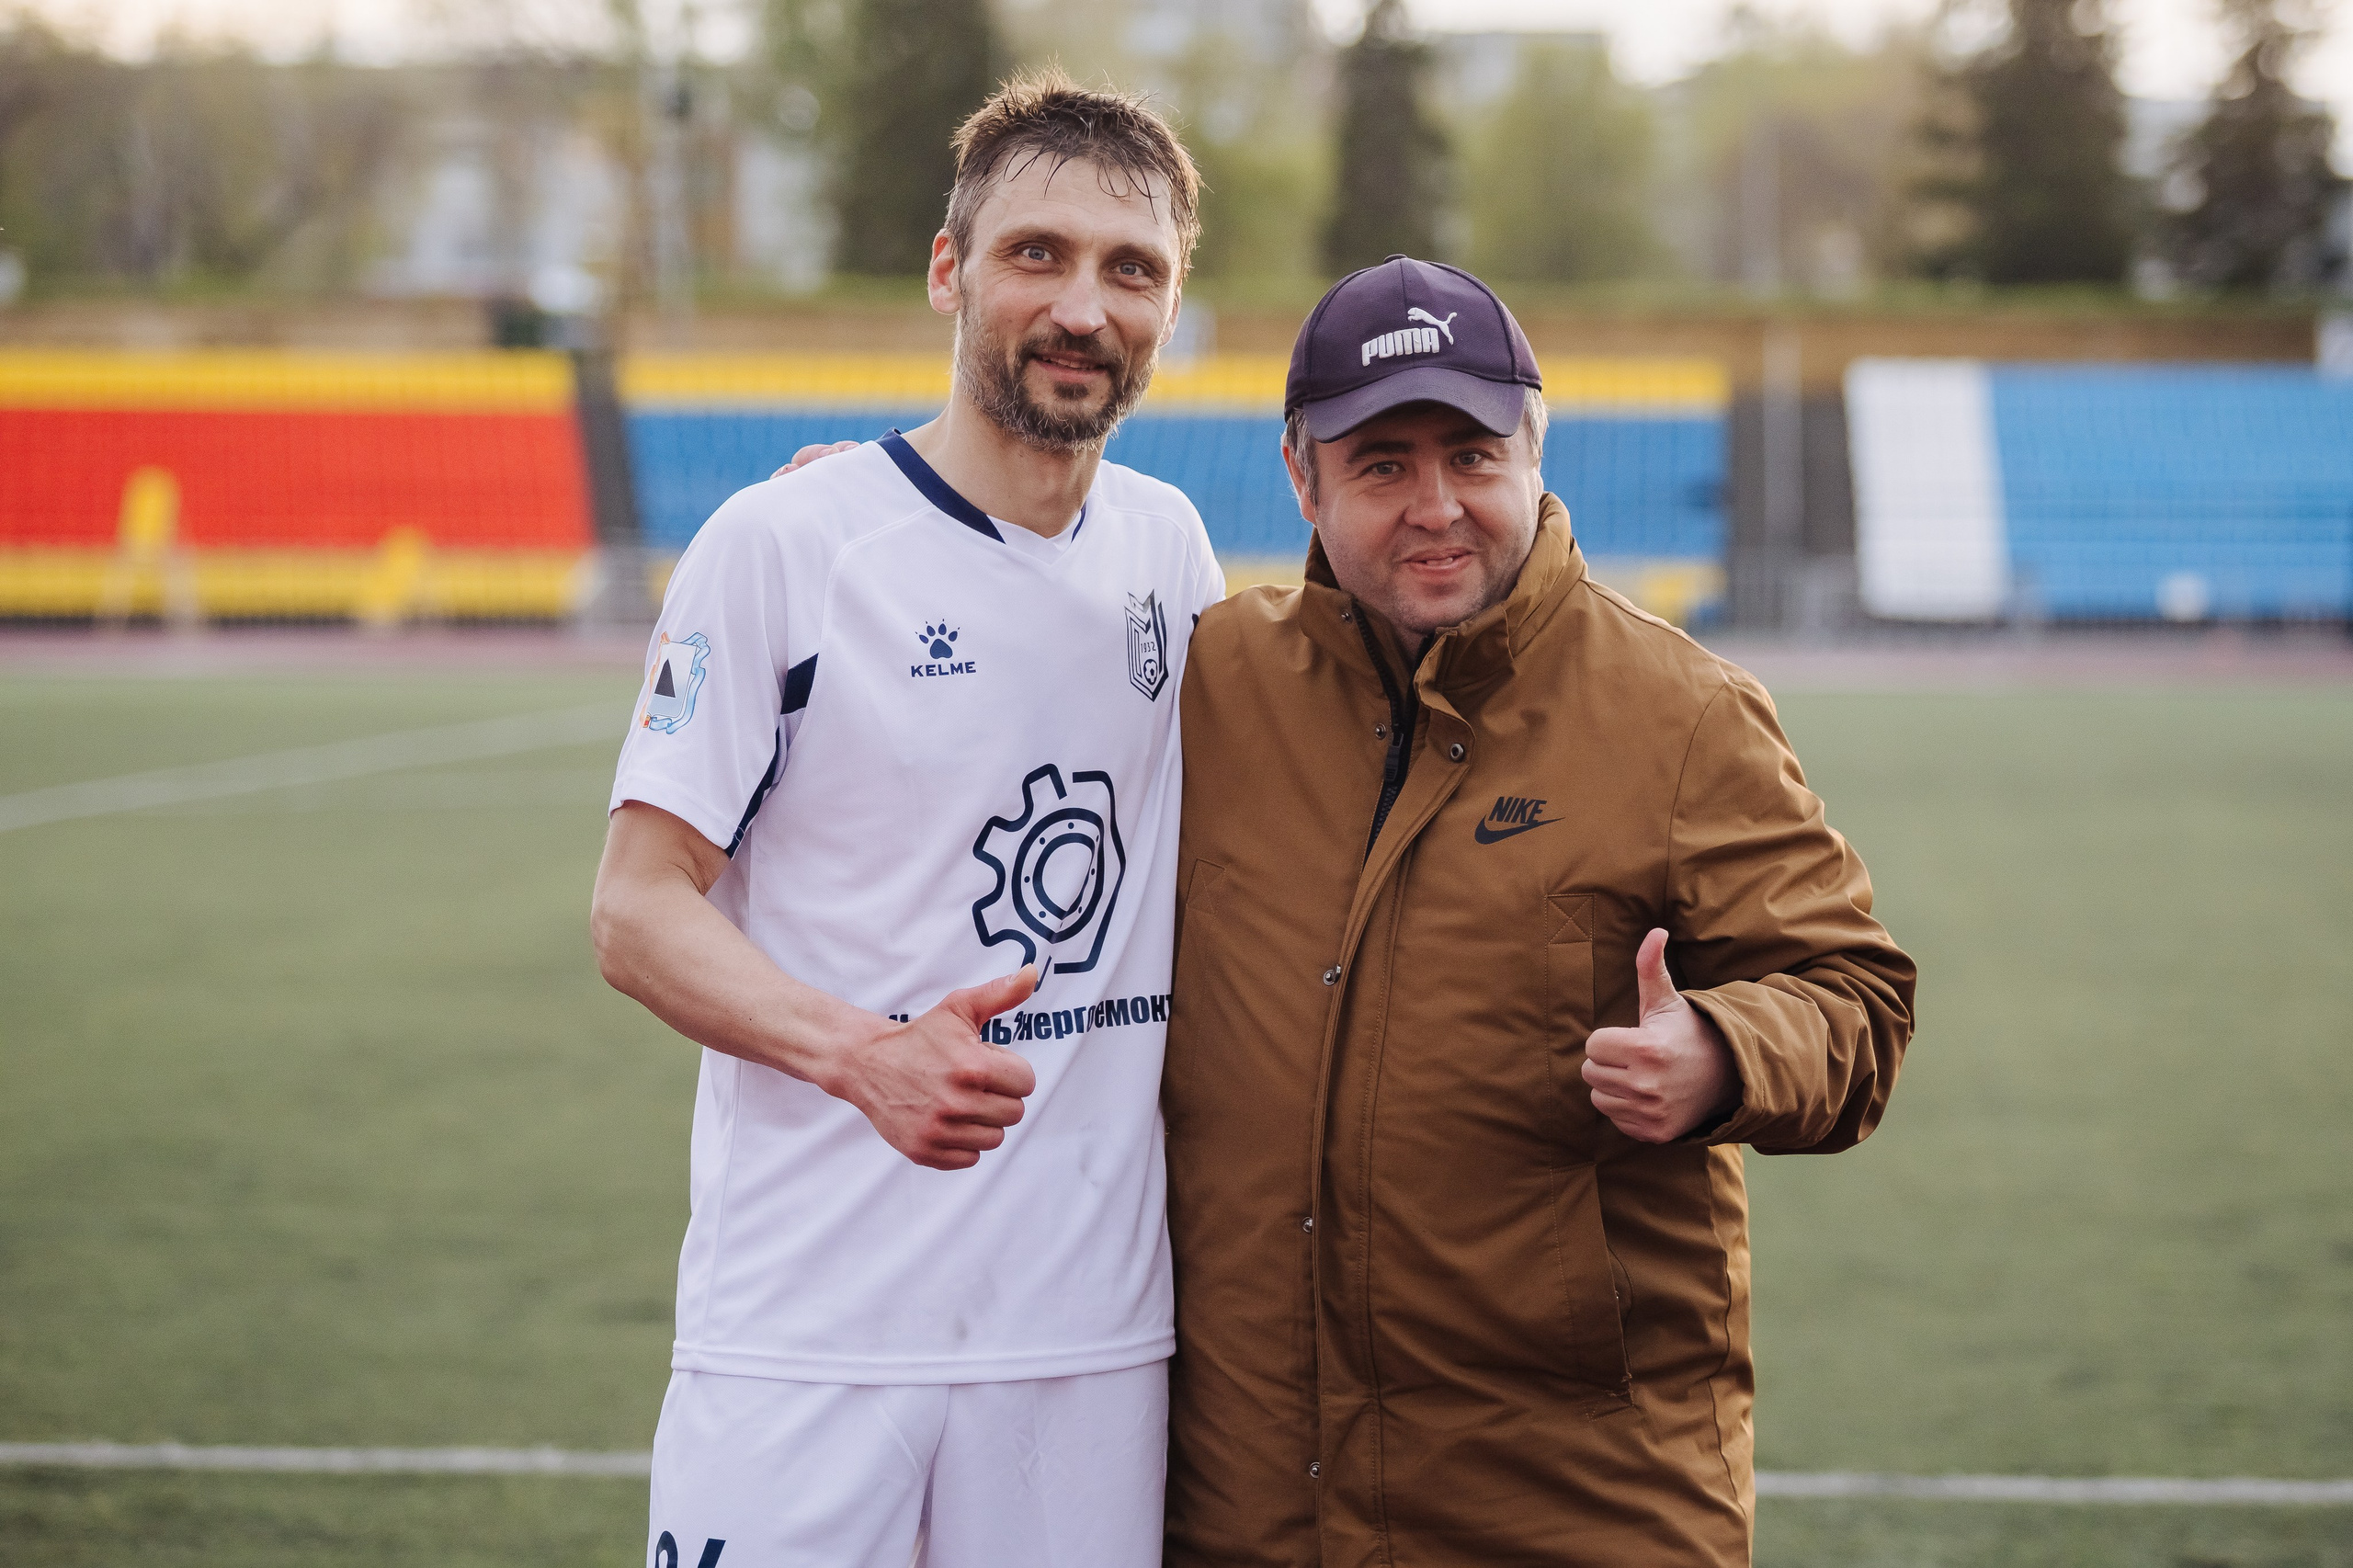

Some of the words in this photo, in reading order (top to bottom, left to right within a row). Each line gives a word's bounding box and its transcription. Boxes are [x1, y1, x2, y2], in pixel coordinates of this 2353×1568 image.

[1361, 327, 1440, 367] PUMA
[1140, 641, 1157, 653] 1932
[910, 661, 977, 678] KELME
[1488, 796, 1548, 825] NIKE
